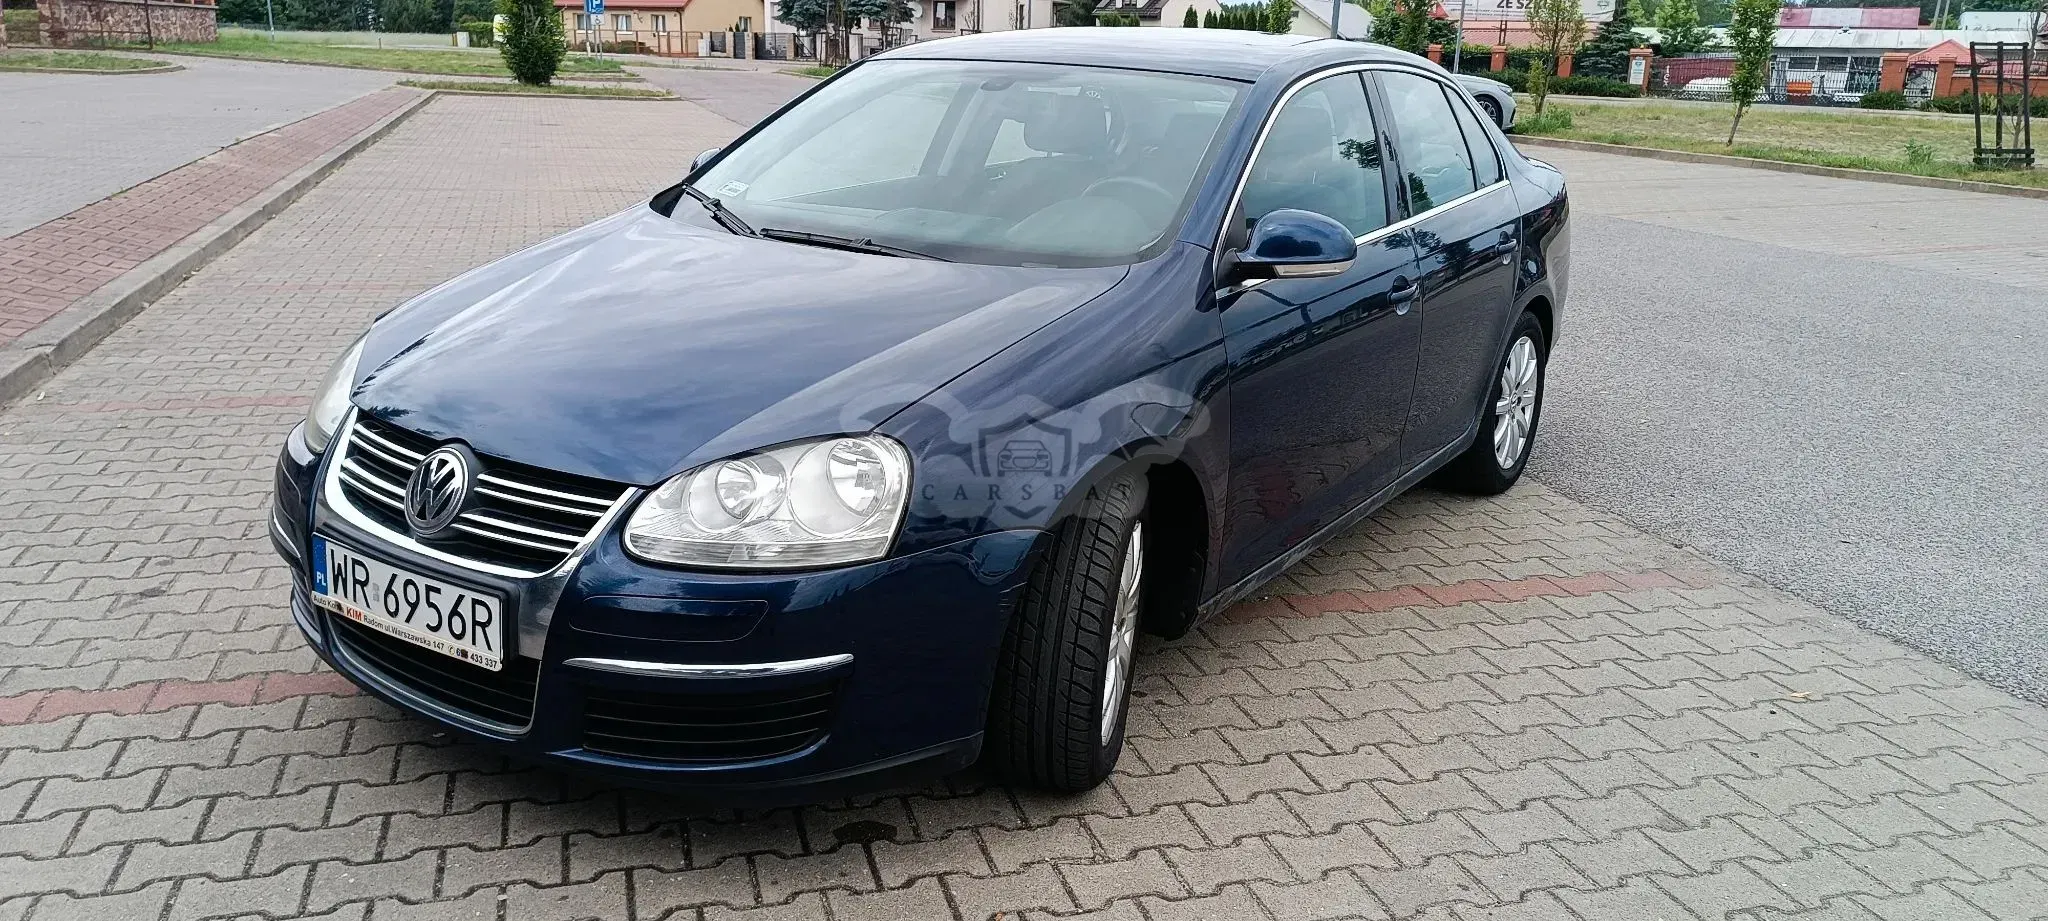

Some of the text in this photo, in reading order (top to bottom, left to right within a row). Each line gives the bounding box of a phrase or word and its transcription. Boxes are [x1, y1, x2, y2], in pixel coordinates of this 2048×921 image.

[316, 571, 327, 586] PL
[331, 548, 493, 652] WR 6956R
[313, 595, 327, 606] Auto
[346, 607, 362, 621] KIM
[364, 615, 383, 630] Radom
[433, 641, 445, 651] 147
[470, 652, 483, 664] 433
[484, 658, 497, 669] 337
